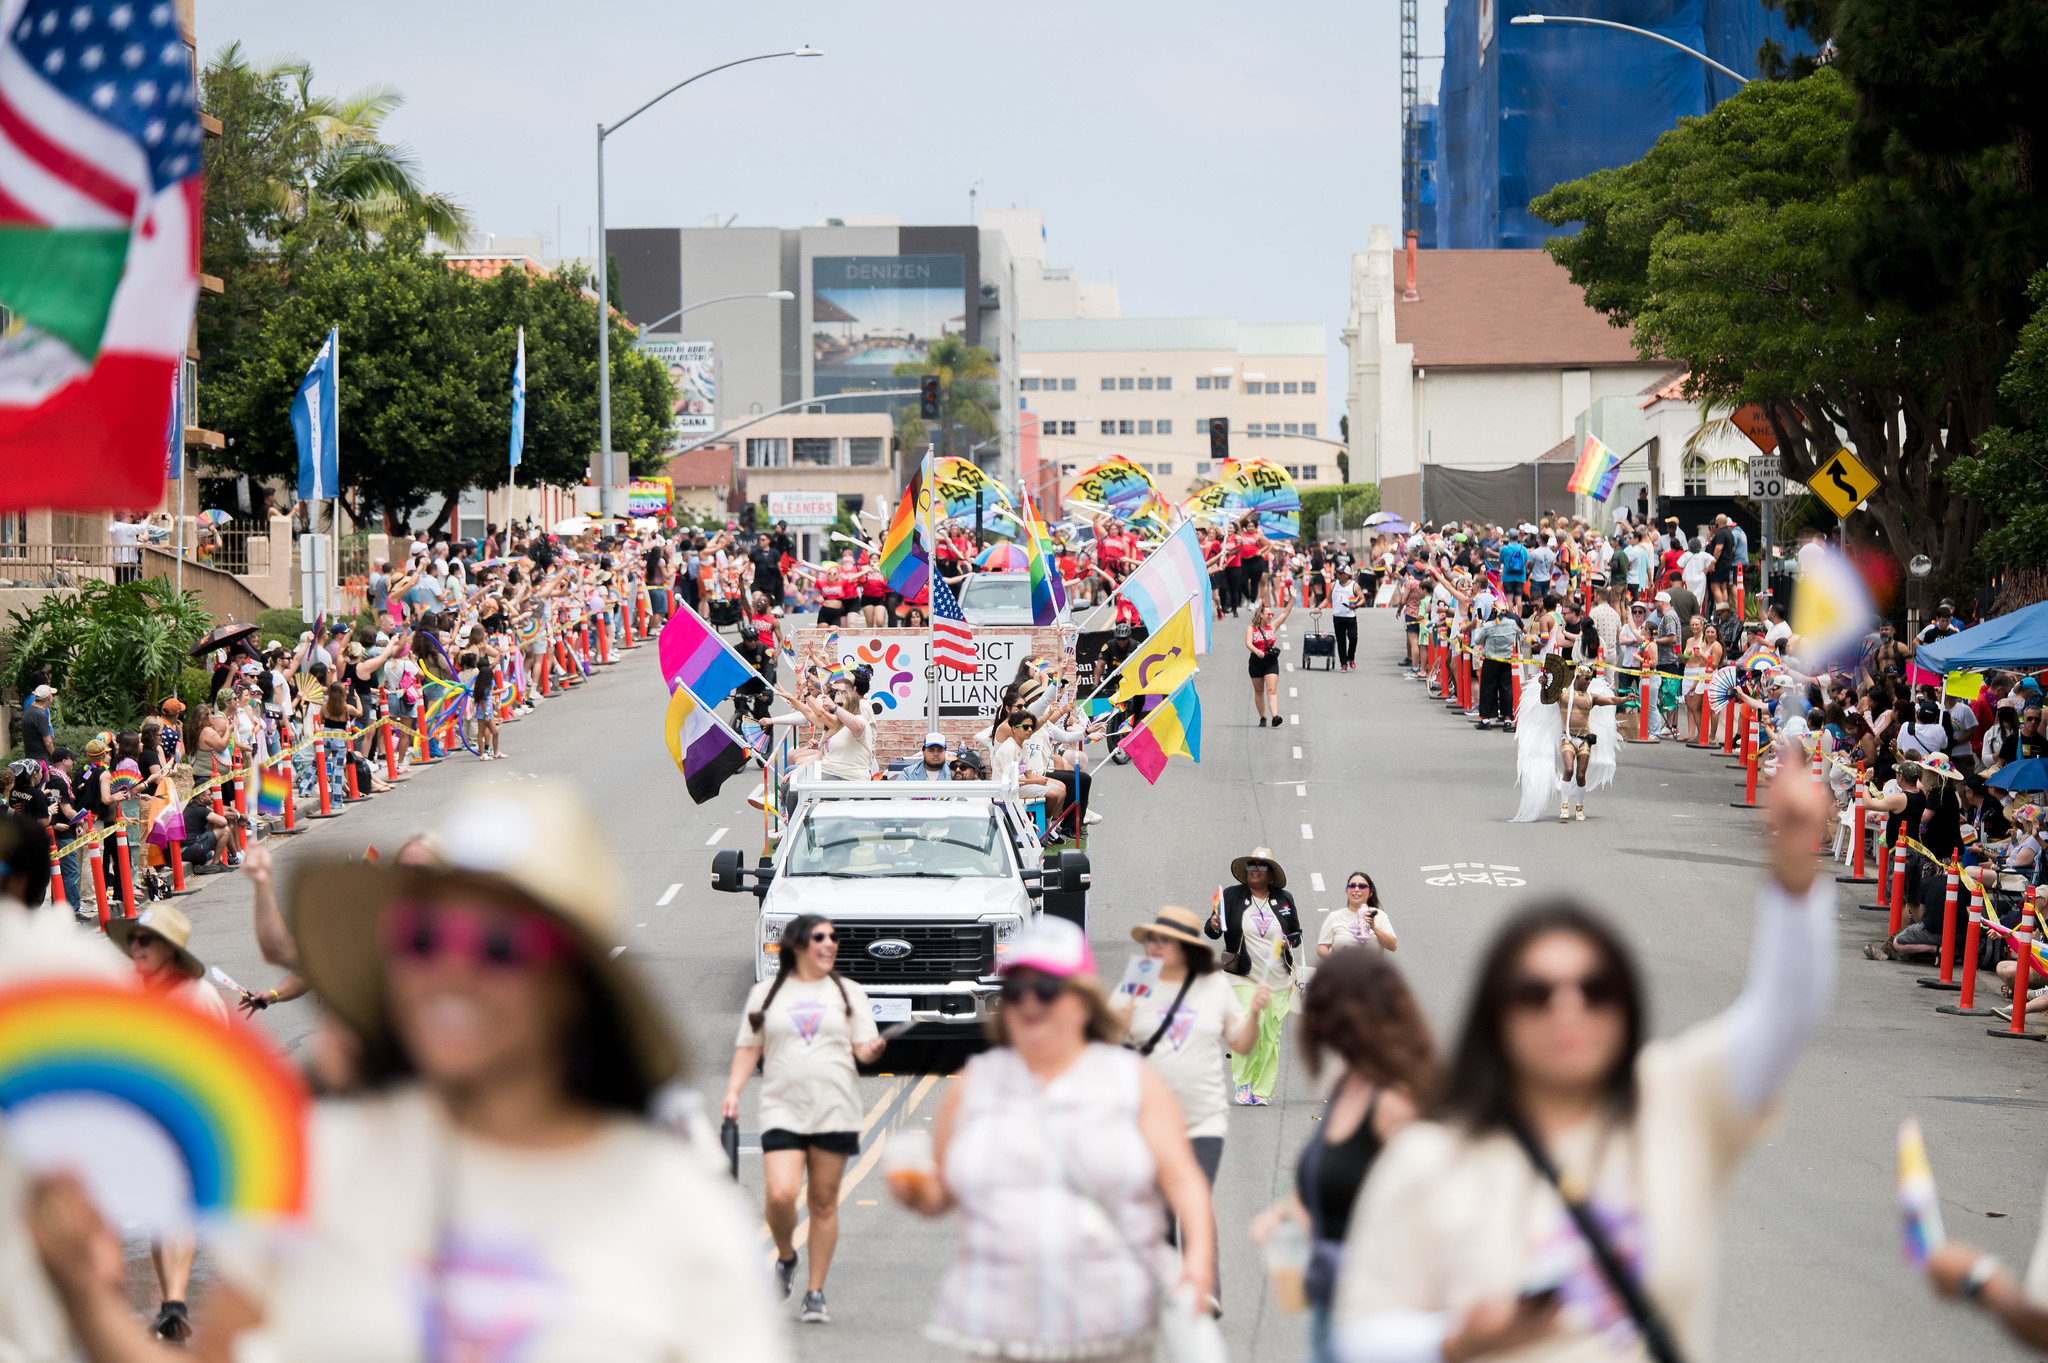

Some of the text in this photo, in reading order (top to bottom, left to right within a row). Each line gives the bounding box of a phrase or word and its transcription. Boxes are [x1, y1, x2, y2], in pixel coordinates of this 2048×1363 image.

[845, 263, 930, 280] DENIZEN
[1749, 426, 1774, 436] AHE
[1754, 470, 1780, 478] LIMIT
[642, 481, 667, 494] OUR
[1752, 480, 1781, 496] 30
[771, 502, 833, 515] CLEANERS
[924, 684, 1010, 704] LLIANC
[879, 944, 902, 956] Ford
